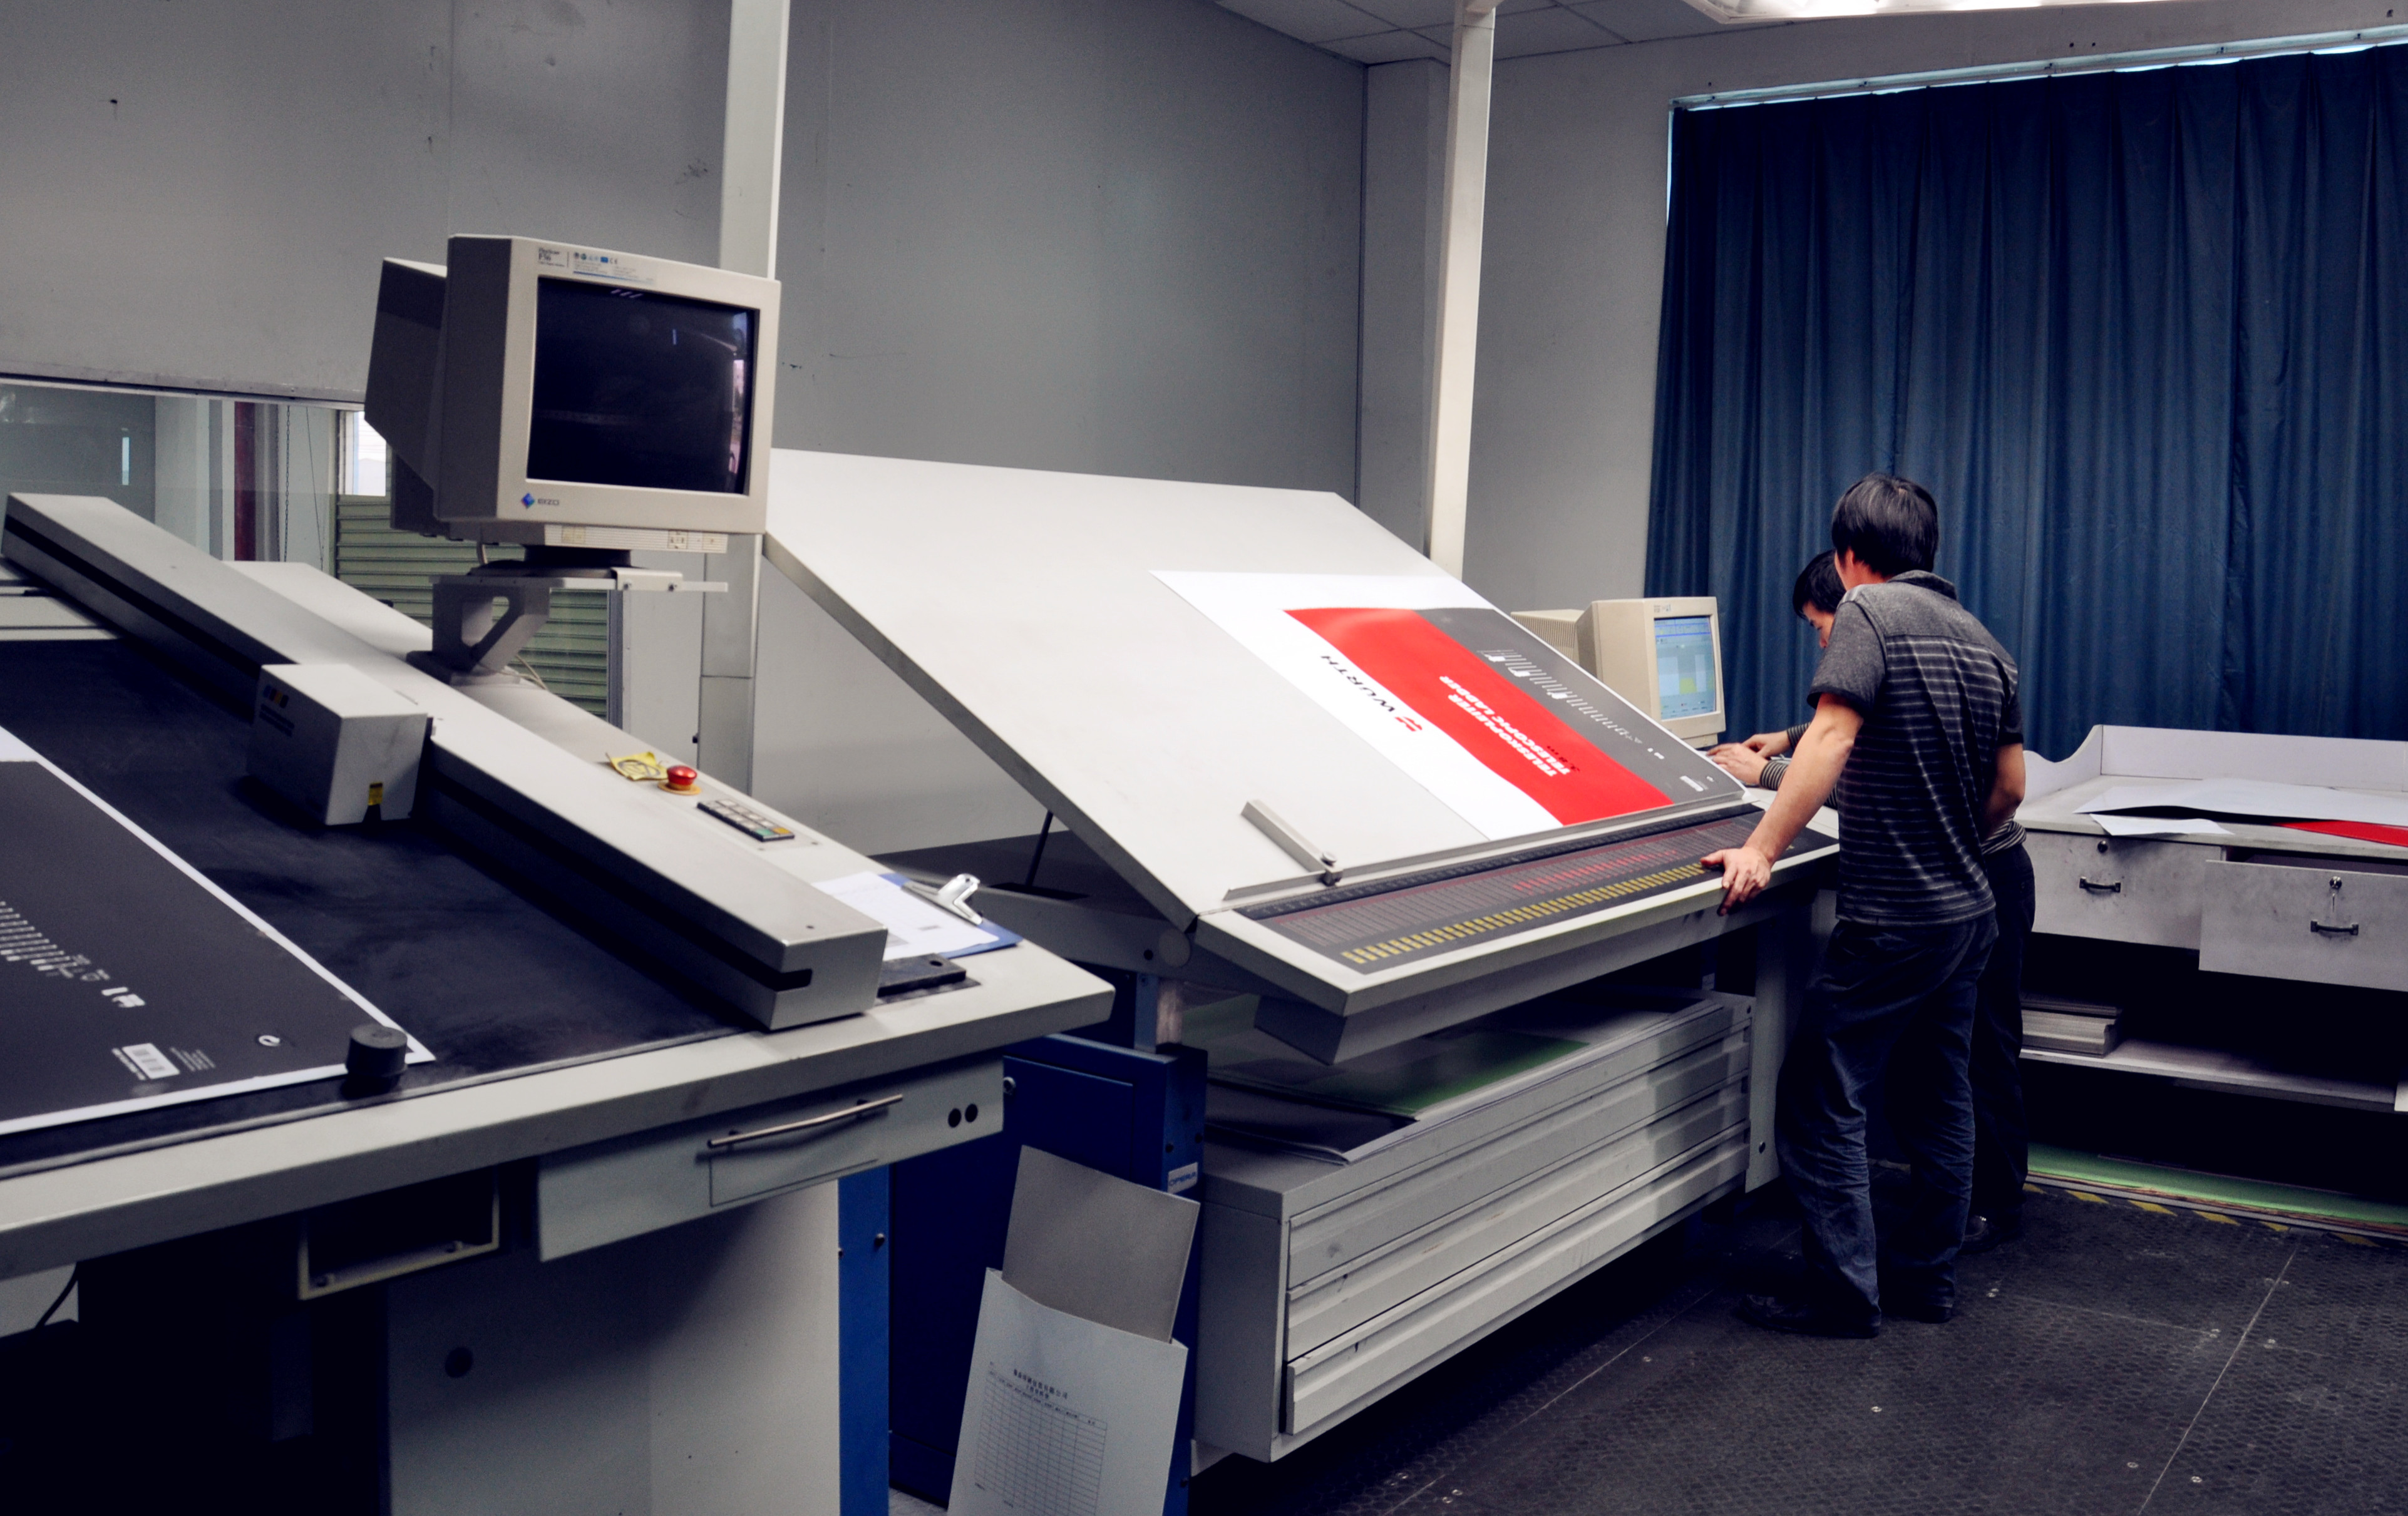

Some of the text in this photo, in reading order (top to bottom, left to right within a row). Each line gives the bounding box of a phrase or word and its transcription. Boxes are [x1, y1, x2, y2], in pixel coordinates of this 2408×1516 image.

[1439, 676, 1570, 774] TELESCOPIC LADDER
[1448, 694, 1557, 777] TELESKOPLEITER
